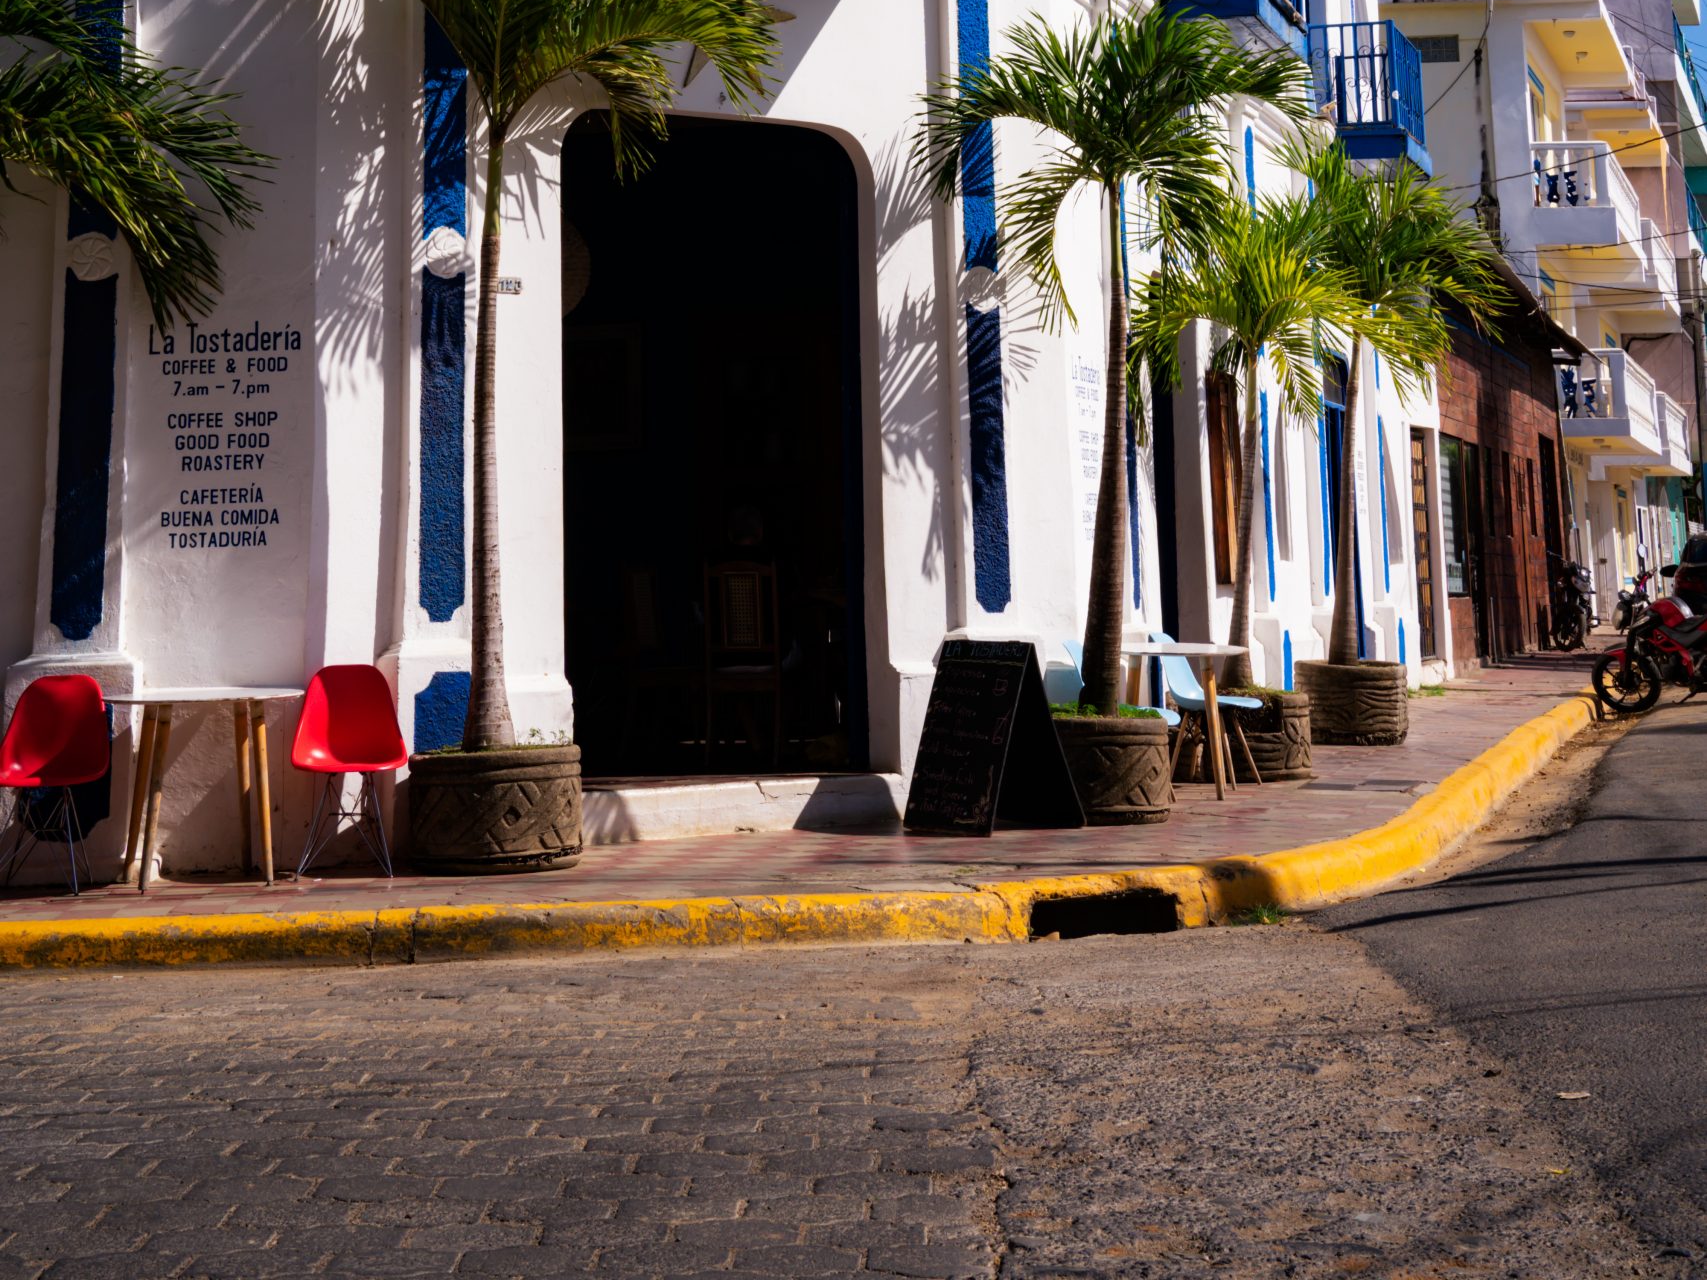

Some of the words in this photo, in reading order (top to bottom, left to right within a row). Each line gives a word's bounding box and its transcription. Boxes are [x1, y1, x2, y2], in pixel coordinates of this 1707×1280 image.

[149, 324, 175, 355] La
[186, 320, 302, 354] Tostadería
[162, 358, 216, 375] COFFEE
[226, 358, 237, 373] &
[247, 356, 288, 372] FOOD
[173, 380, 209, 397] 7.am
[232, 379, 270, 398] 7.pm
[167, 412, 223, 429] COFFEE
[234, 411, 278, 427] SHOP
[175, 434, 219, 450] GOOD
[227, 432, 270, 448] FOOD
[181, 454, 265, 471] ROASTERY
[180, 483, 264, 505] CAFETERÍA
[161, 511, 214, 527] BUENA
[220, 509, 280, 526] COMIDA
[168, 526, 267, 549] TOSTADURÍA
